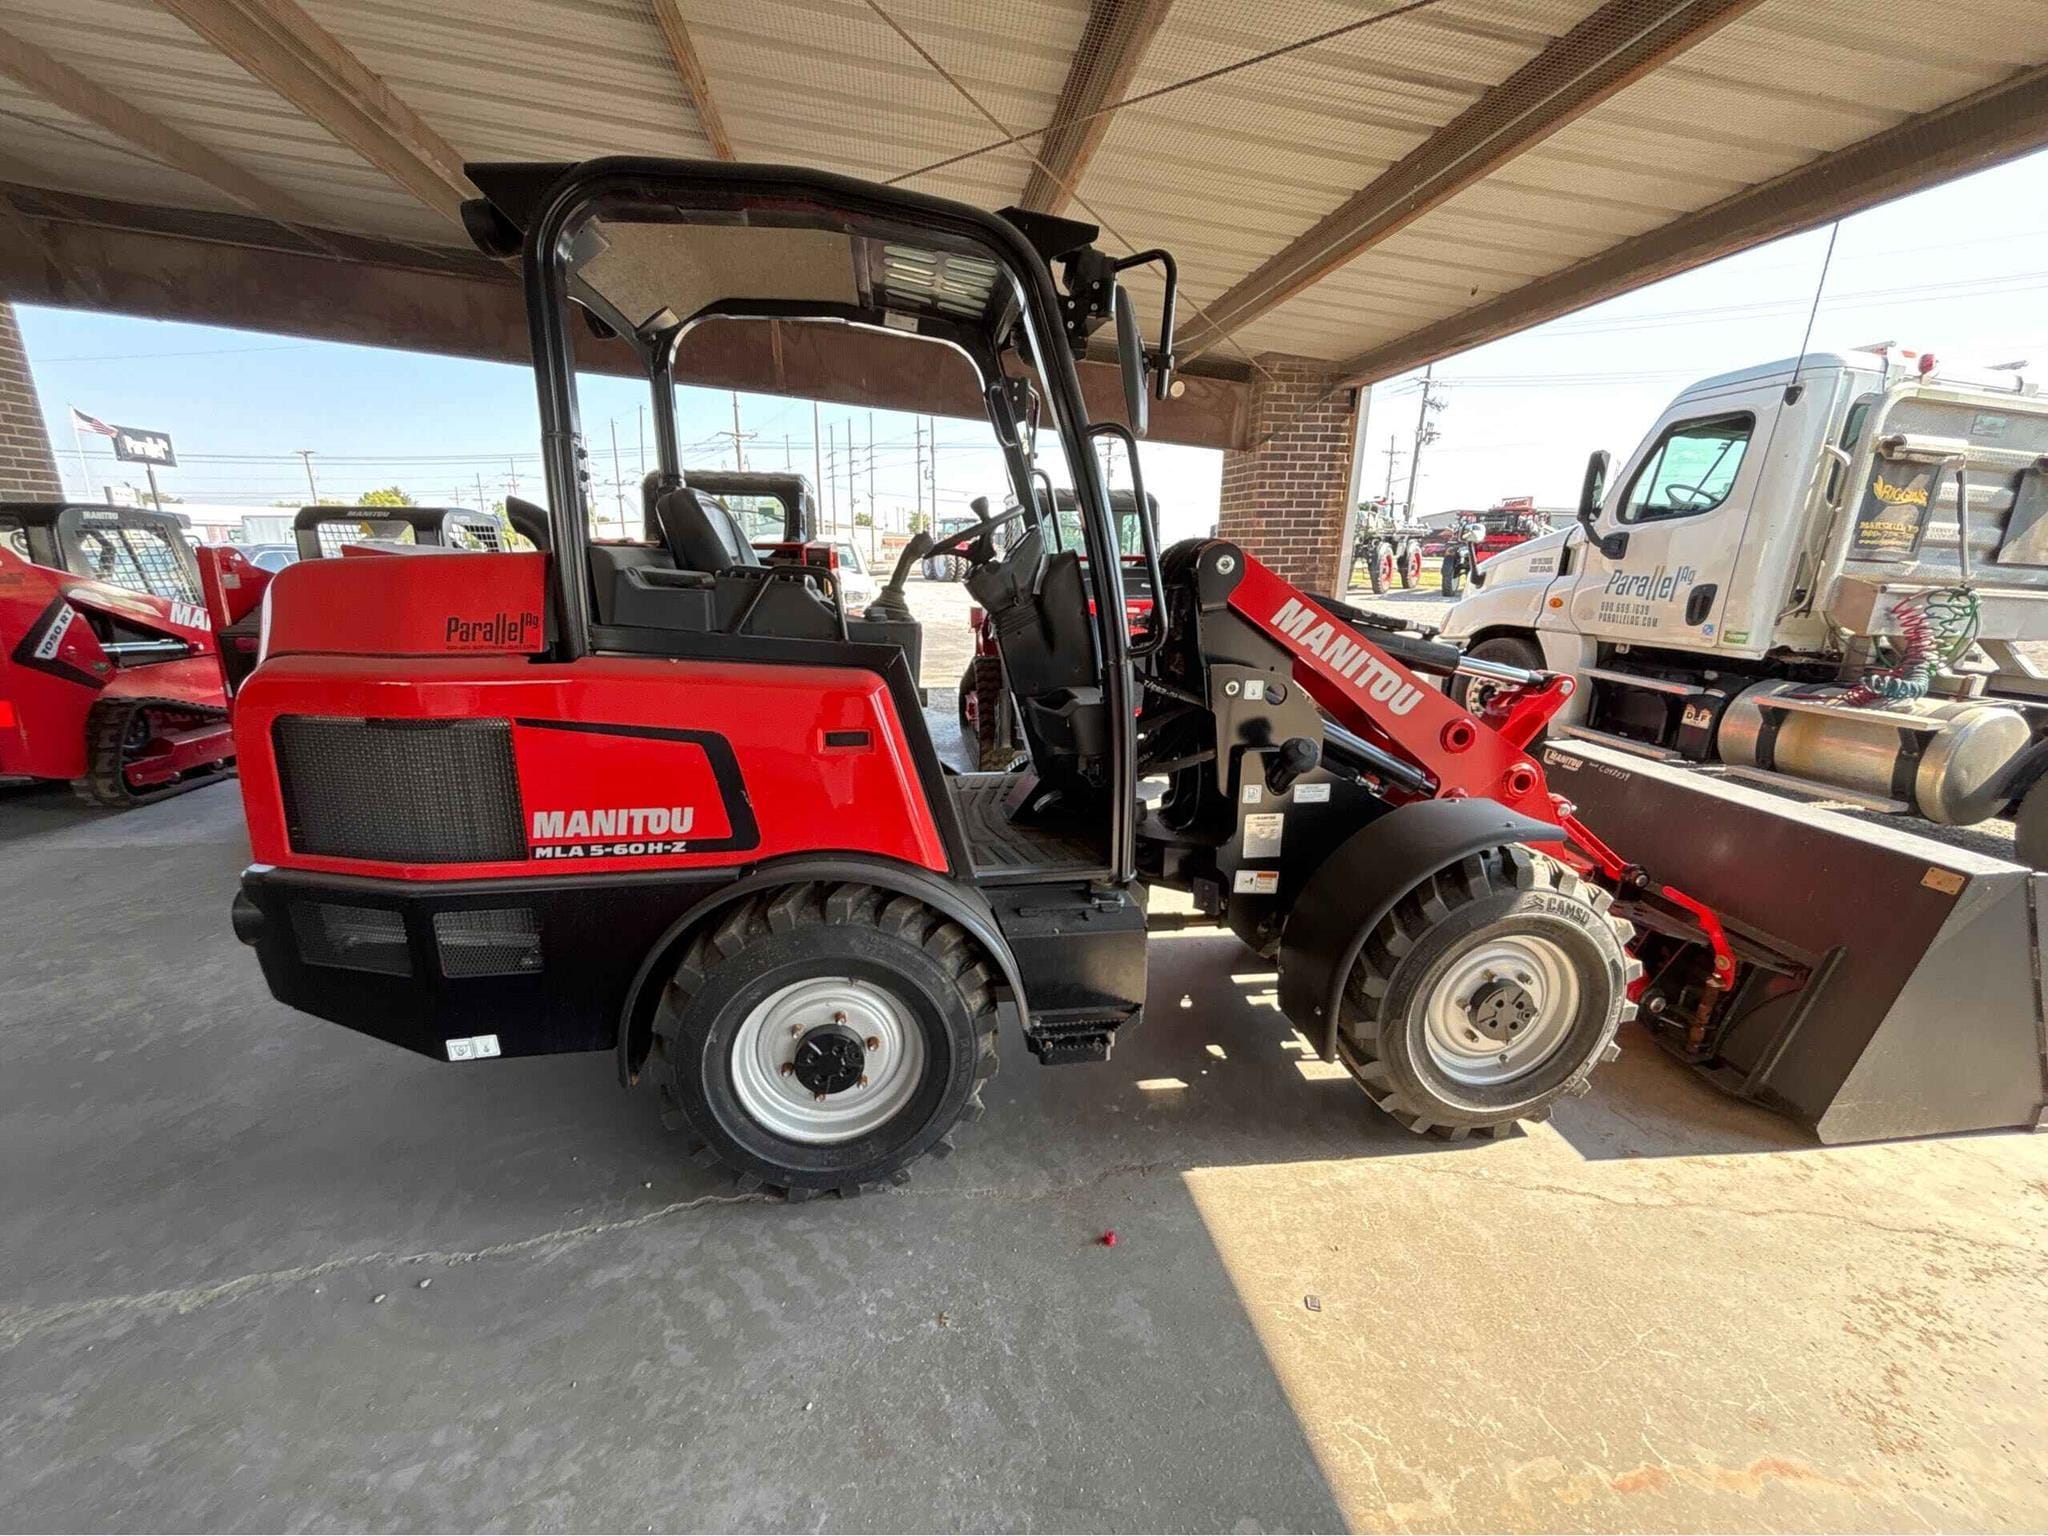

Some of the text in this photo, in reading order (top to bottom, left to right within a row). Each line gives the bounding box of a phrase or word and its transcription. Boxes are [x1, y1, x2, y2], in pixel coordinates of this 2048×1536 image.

[1605, 565, 1696, 602] Parallel Ag
[60, 609, 74, 629] RT
[446, 612, 538, 644] Parallel Ag
[1270, 597, 1425, 715] MANITOU
[532, 807, 694, 838] MANITOU
[535, 841, 686, 859] MLA 5-60 H-Z
[1546, 897, 1590, 927] CAMSO
